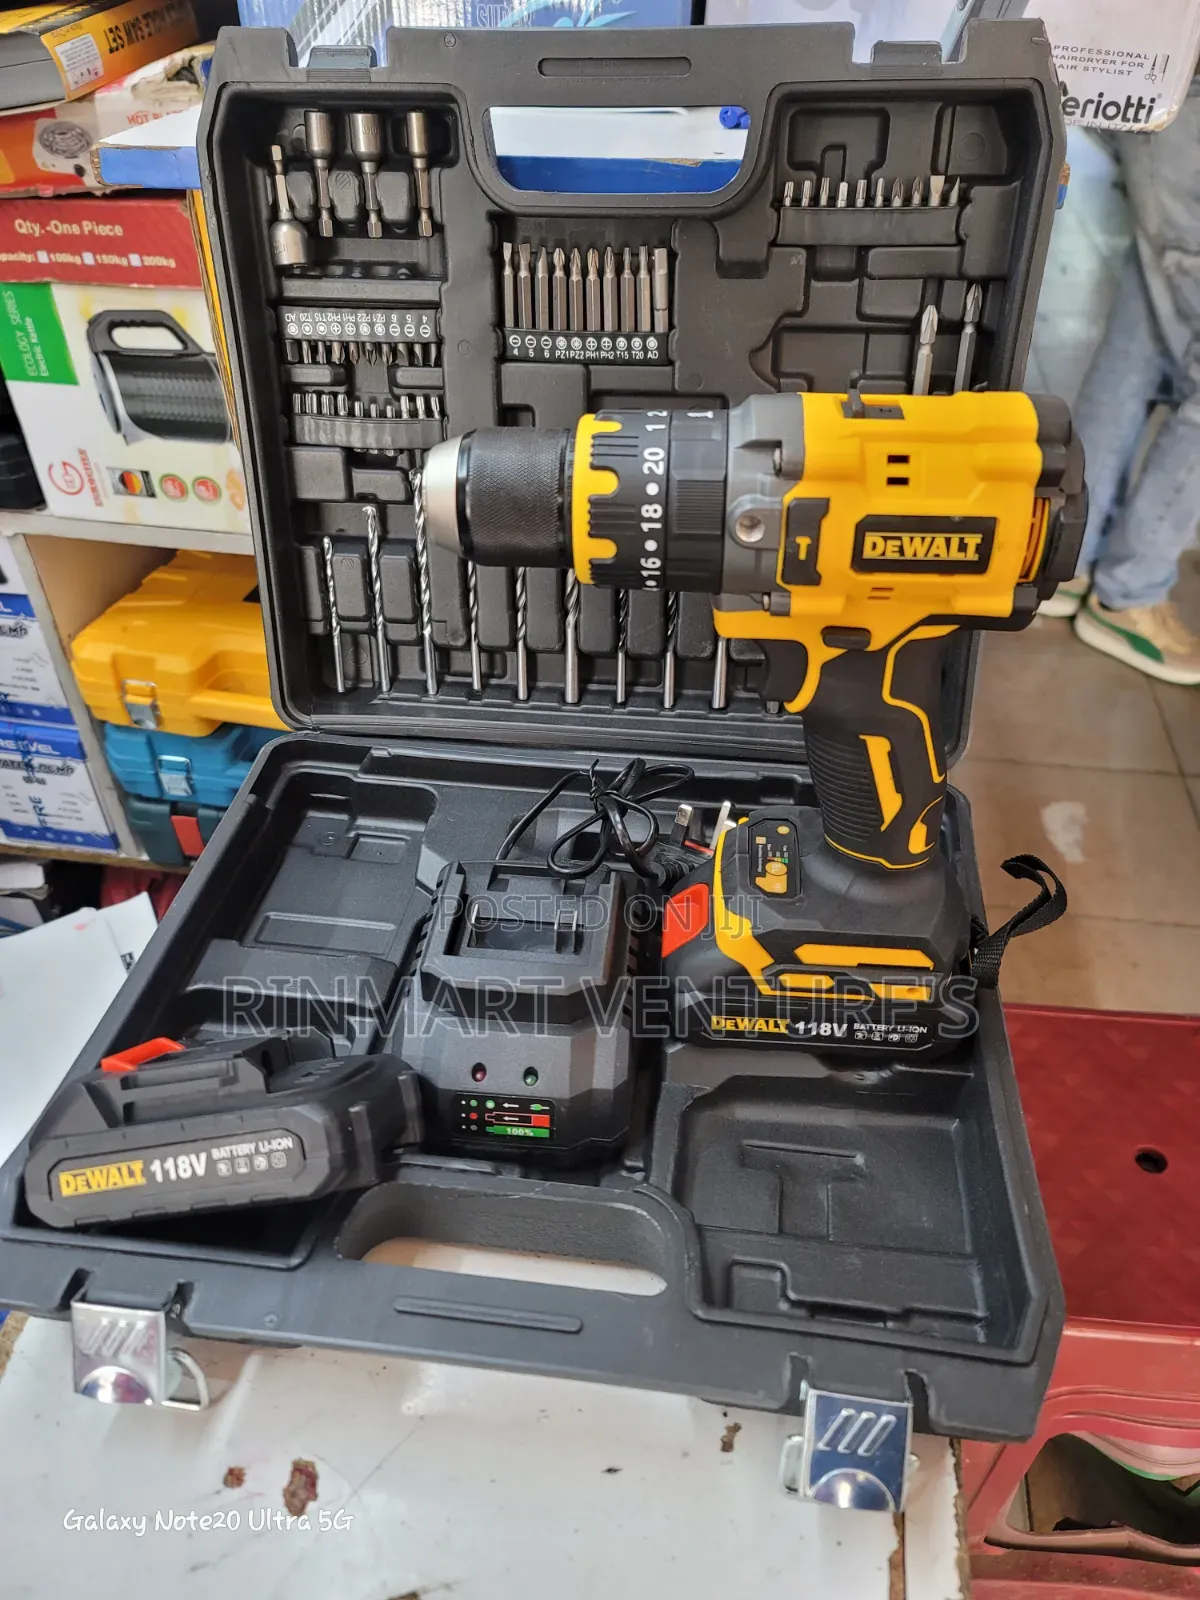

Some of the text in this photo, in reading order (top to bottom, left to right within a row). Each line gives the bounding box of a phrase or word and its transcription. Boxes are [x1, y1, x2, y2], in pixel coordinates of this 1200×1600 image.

[1053, 44, 1150, 60] PROFESSIONAL
[1052, 54, 1144, 68] HAIRDRYER FOR
[1083, 66, 1133, 76] STYLIST
[1059, 81, 1156, 124] eriotti
[285, 313, 296, 322] AD
[406, 314, 412, 322] 5
[422, 315, 428, 324] 4
[513, 348, 659, 360] 4 5 6 PZ1 PZ2 PH1 PH2 T15 T20 AD
[642, 447, 665, 476] 20
[640, 503, 663, 533] 18
[640, 557, 662, 578] 16
[795, 1021, 848, 1037] 118V
[853, 1022, 928, 1034] BATTERY LI-ION
[506, 1127, 534, 1136] 100%
[211, 1136, 294, 1160] BATTERY LI-ION
[150, 1152, 208, 1183] 118V
